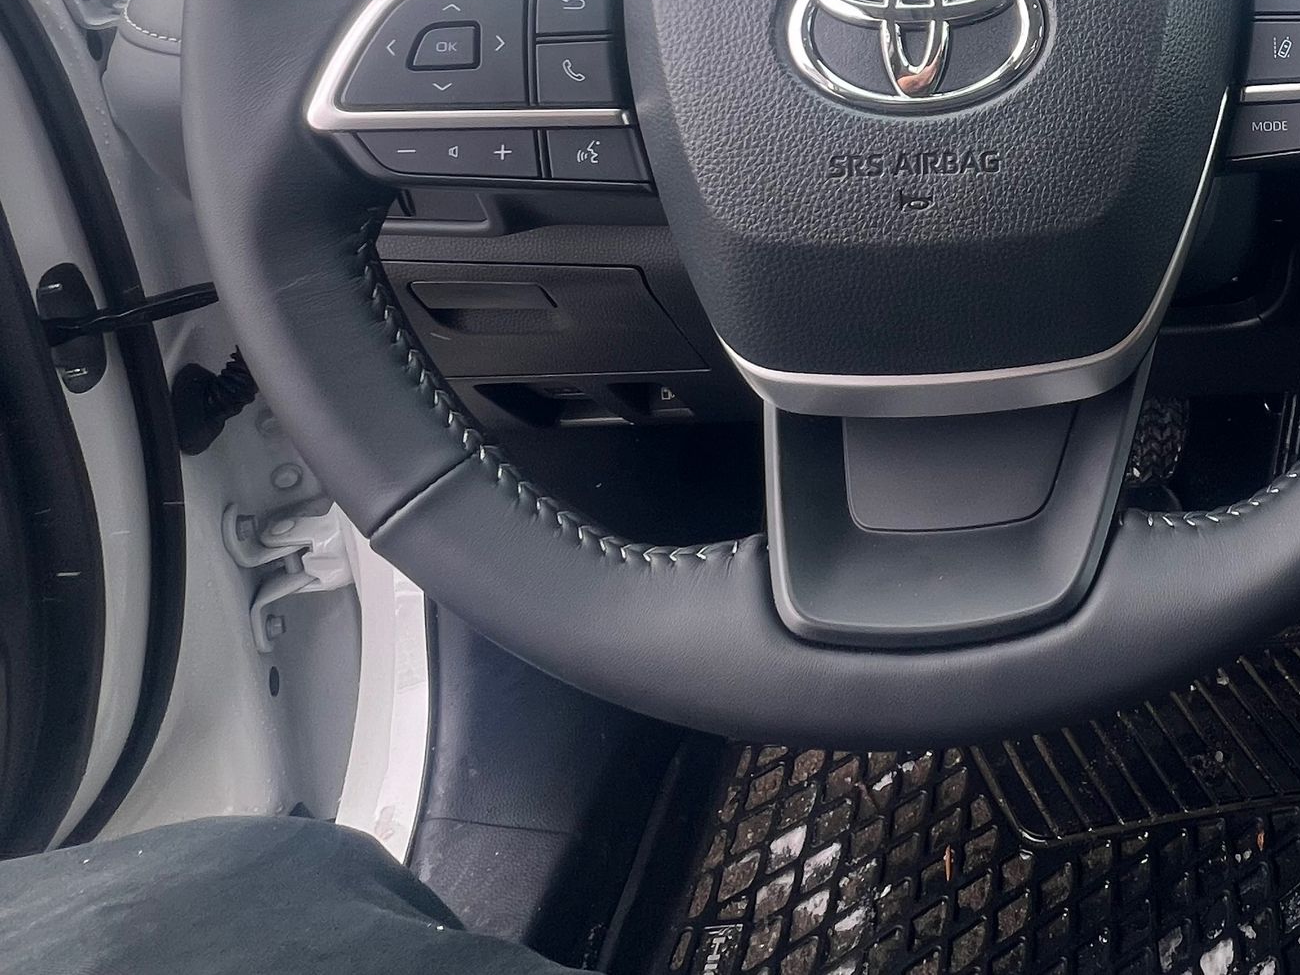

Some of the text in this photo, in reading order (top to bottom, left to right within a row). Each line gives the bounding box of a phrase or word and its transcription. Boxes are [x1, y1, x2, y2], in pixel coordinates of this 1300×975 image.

[436, 41, 457, 52] OK
[1252, 121, 1288, 131] MODE
[828, 150, 1000, 178] SRS AIRBAG
